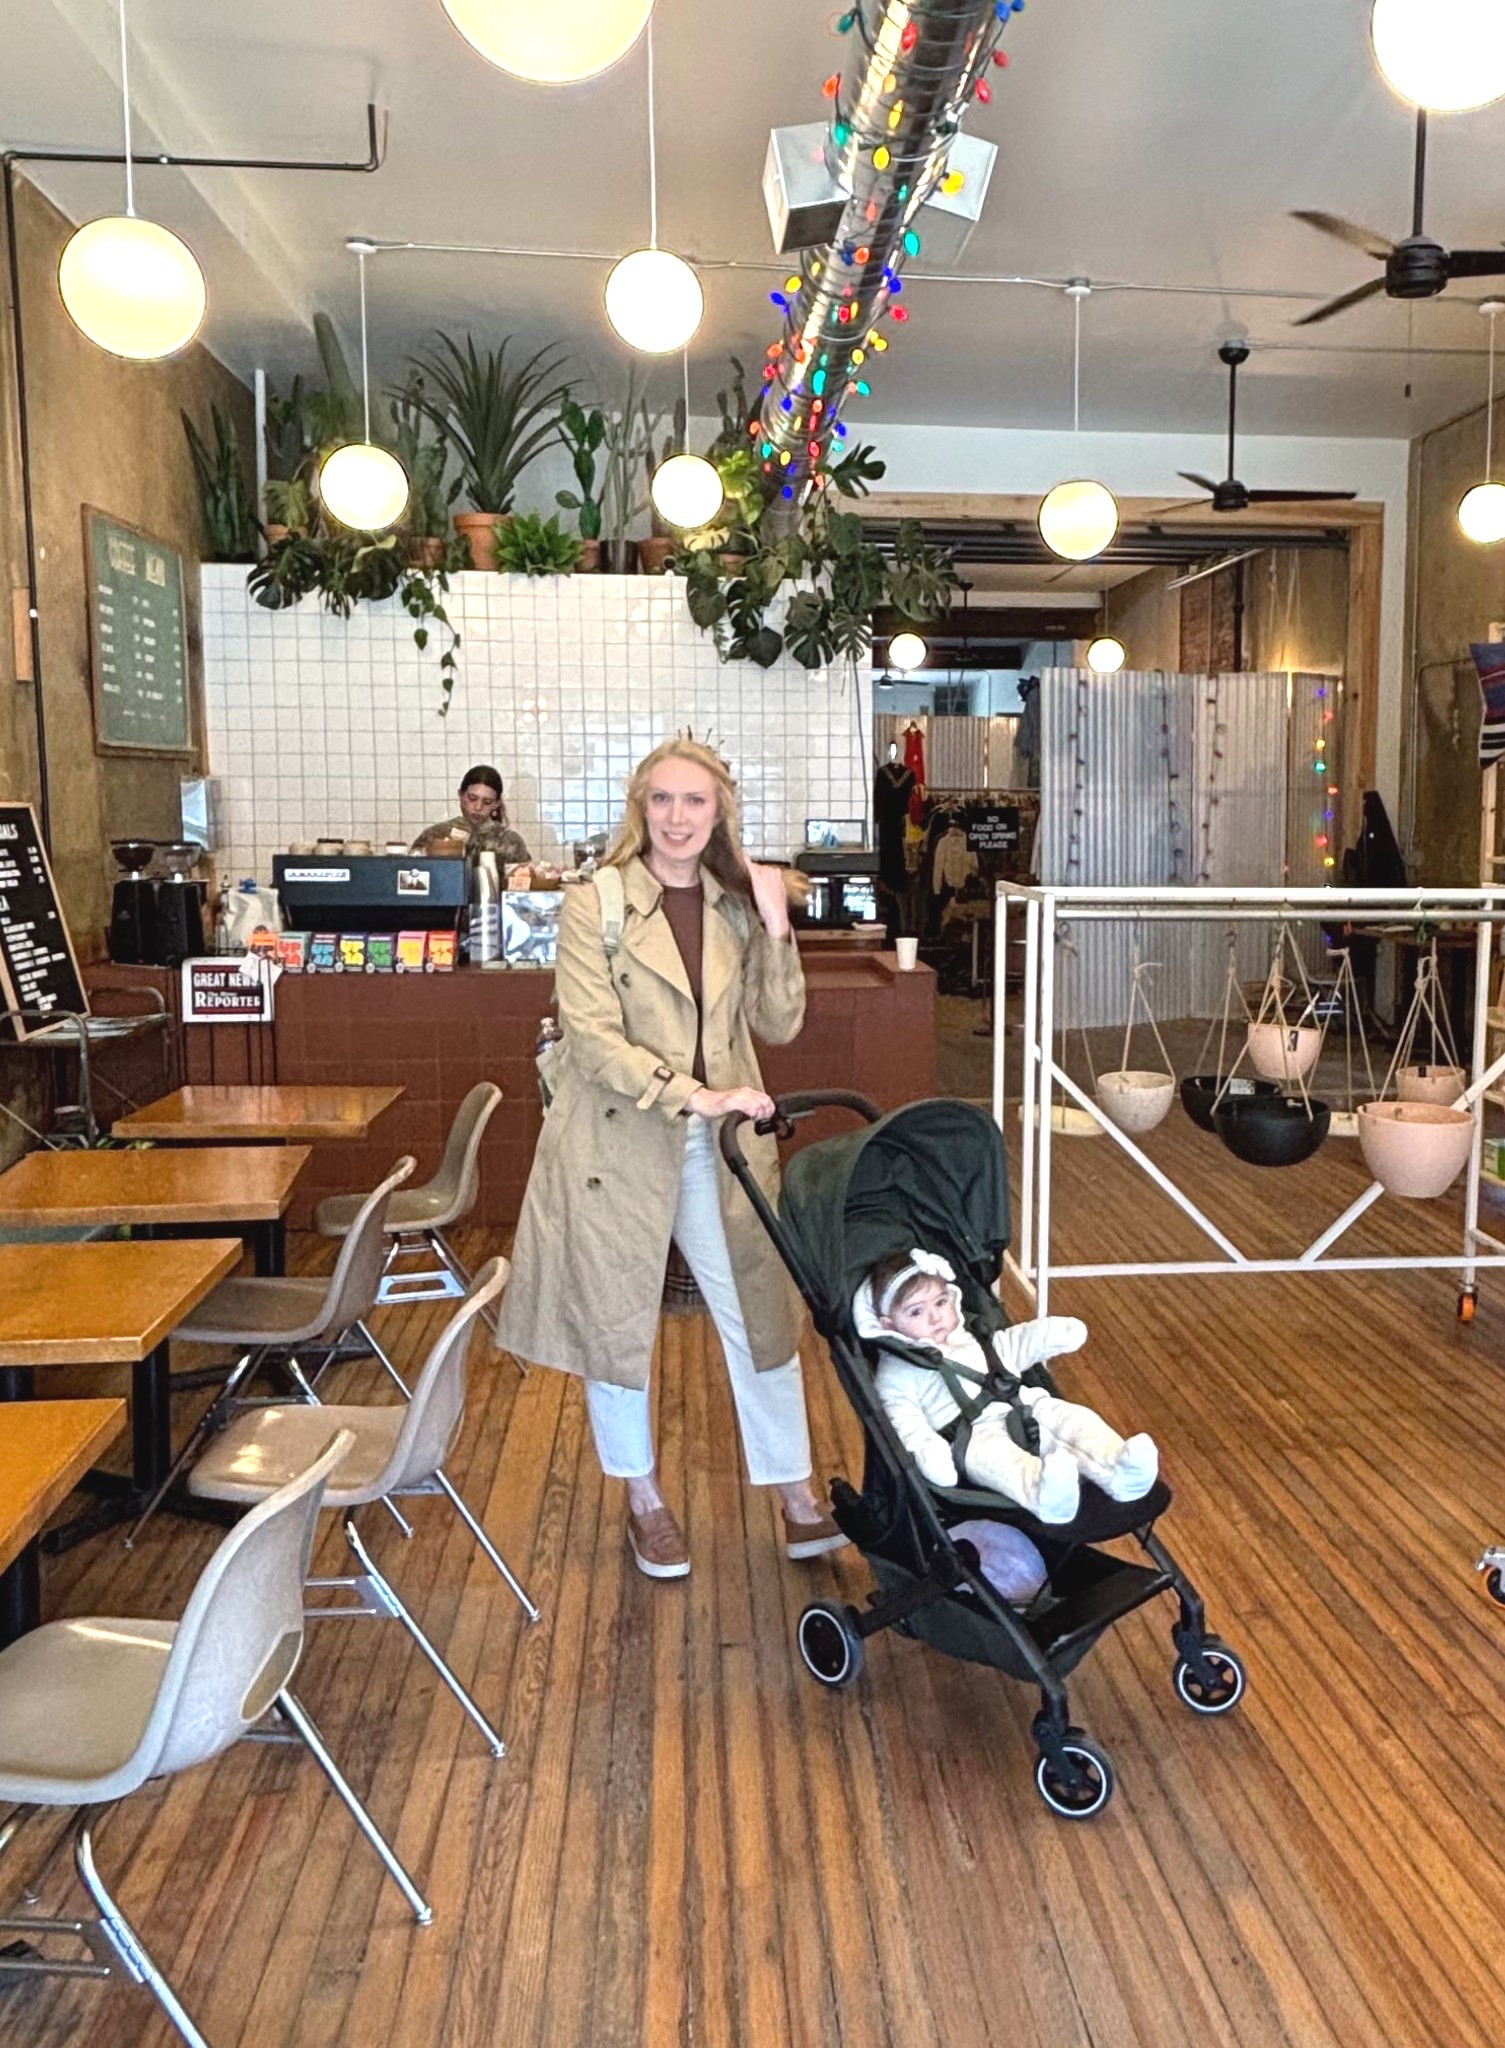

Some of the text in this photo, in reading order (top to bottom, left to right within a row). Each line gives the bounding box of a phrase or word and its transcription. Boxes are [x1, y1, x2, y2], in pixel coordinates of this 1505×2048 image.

[972, 823, 993, 831] FOOD
[969, 832, 989, 840] OPEN
[979, 841, 1008, 849] PLEASE
[193, 972, 226, 987] GREAT
[195, 991, 261, 1007] REPORTER
